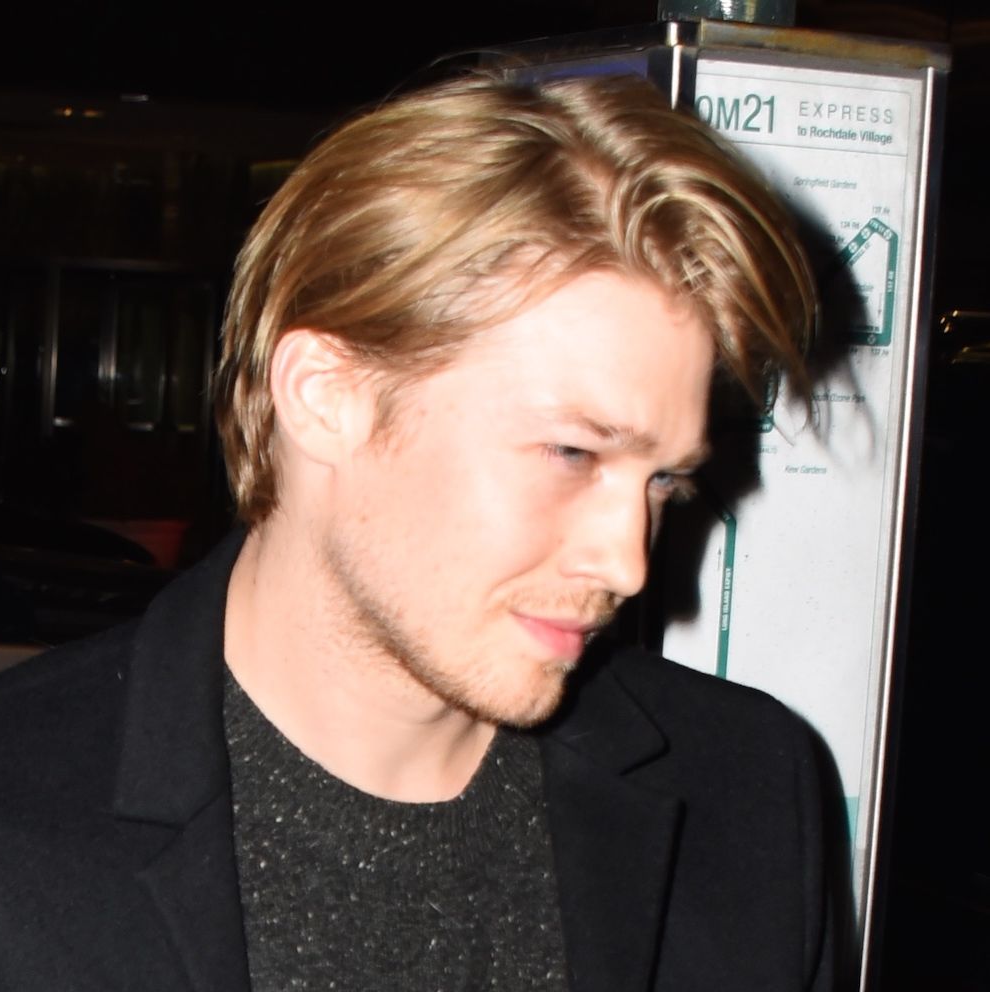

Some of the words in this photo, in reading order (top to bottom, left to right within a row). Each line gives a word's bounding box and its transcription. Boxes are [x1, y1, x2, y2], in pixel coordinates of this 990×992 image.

[799, 101, 894, 124] EXPRESS
[797, 126, 807, 137] to
[810, 126, 857, 141] Rochdale
[860, 131, 893, 145] Village
[793, 177, 829, 188] Springfield
[830, 180, 857, 189] Gardens
[785, 465, 799, 474] Kew
[800, 465, 827, 474] Gardens
